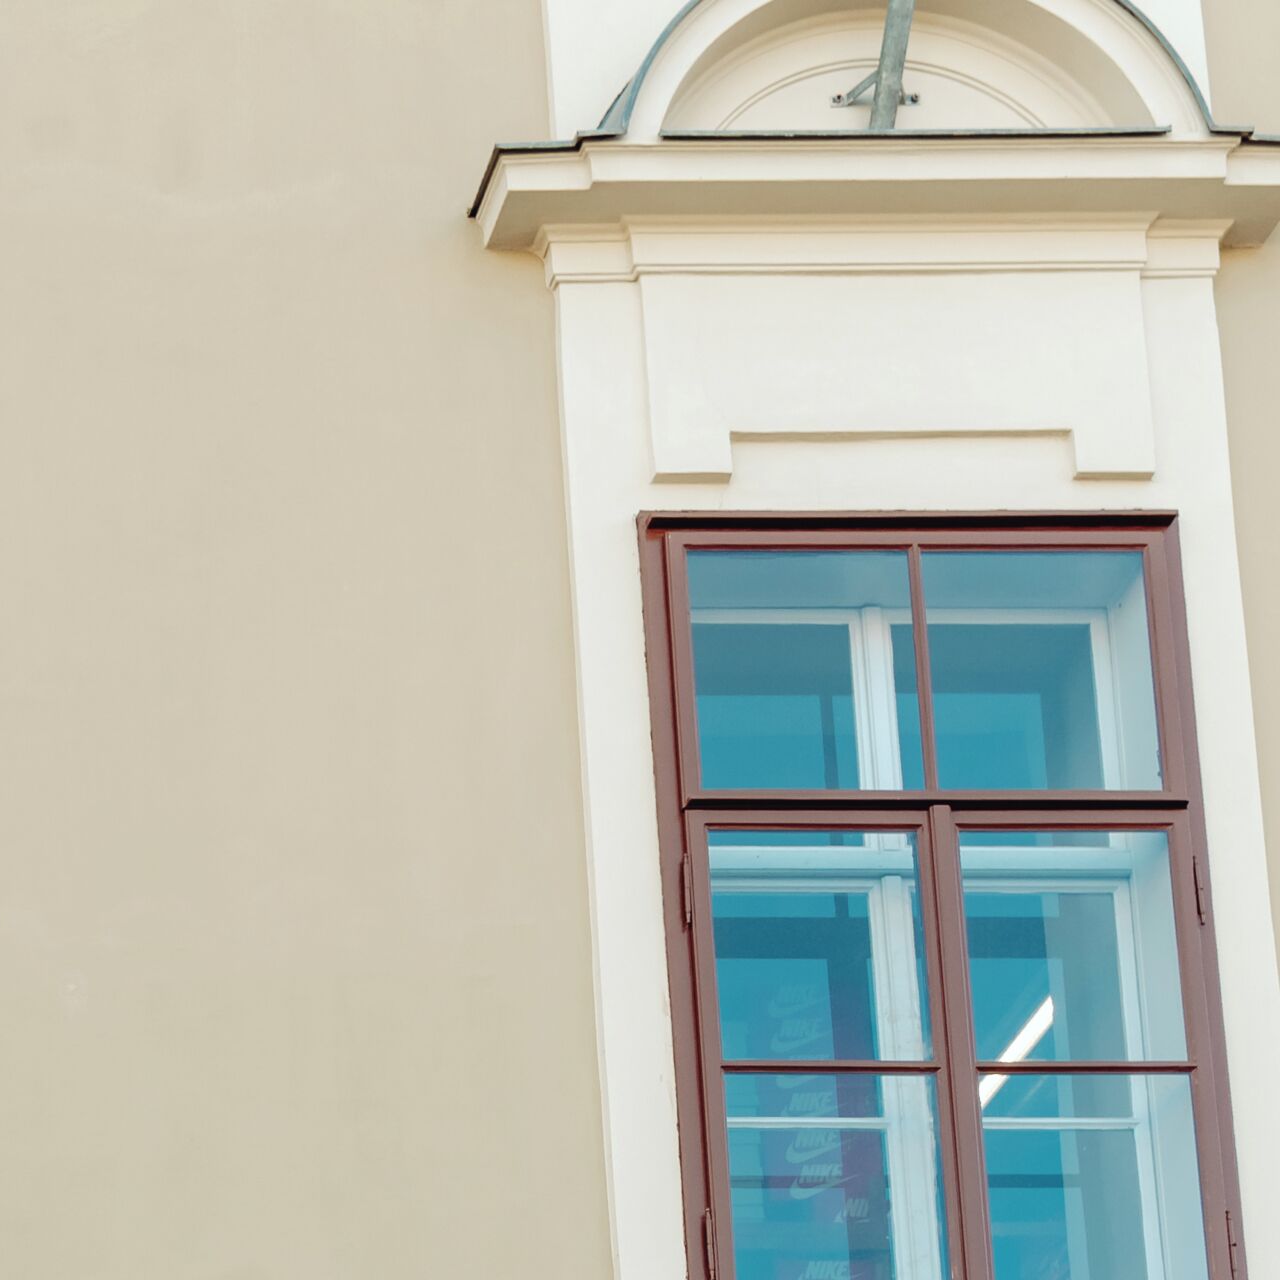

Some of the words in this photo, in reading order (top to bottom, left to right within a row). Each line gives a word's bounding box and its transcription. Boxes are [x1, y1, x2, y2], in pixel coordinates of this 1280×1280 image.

[788, 1092, 833, 1111] NIKE
[798, 1164, 843, 1184] NIKE
[804, 1260, 849, 1279] NIKE
